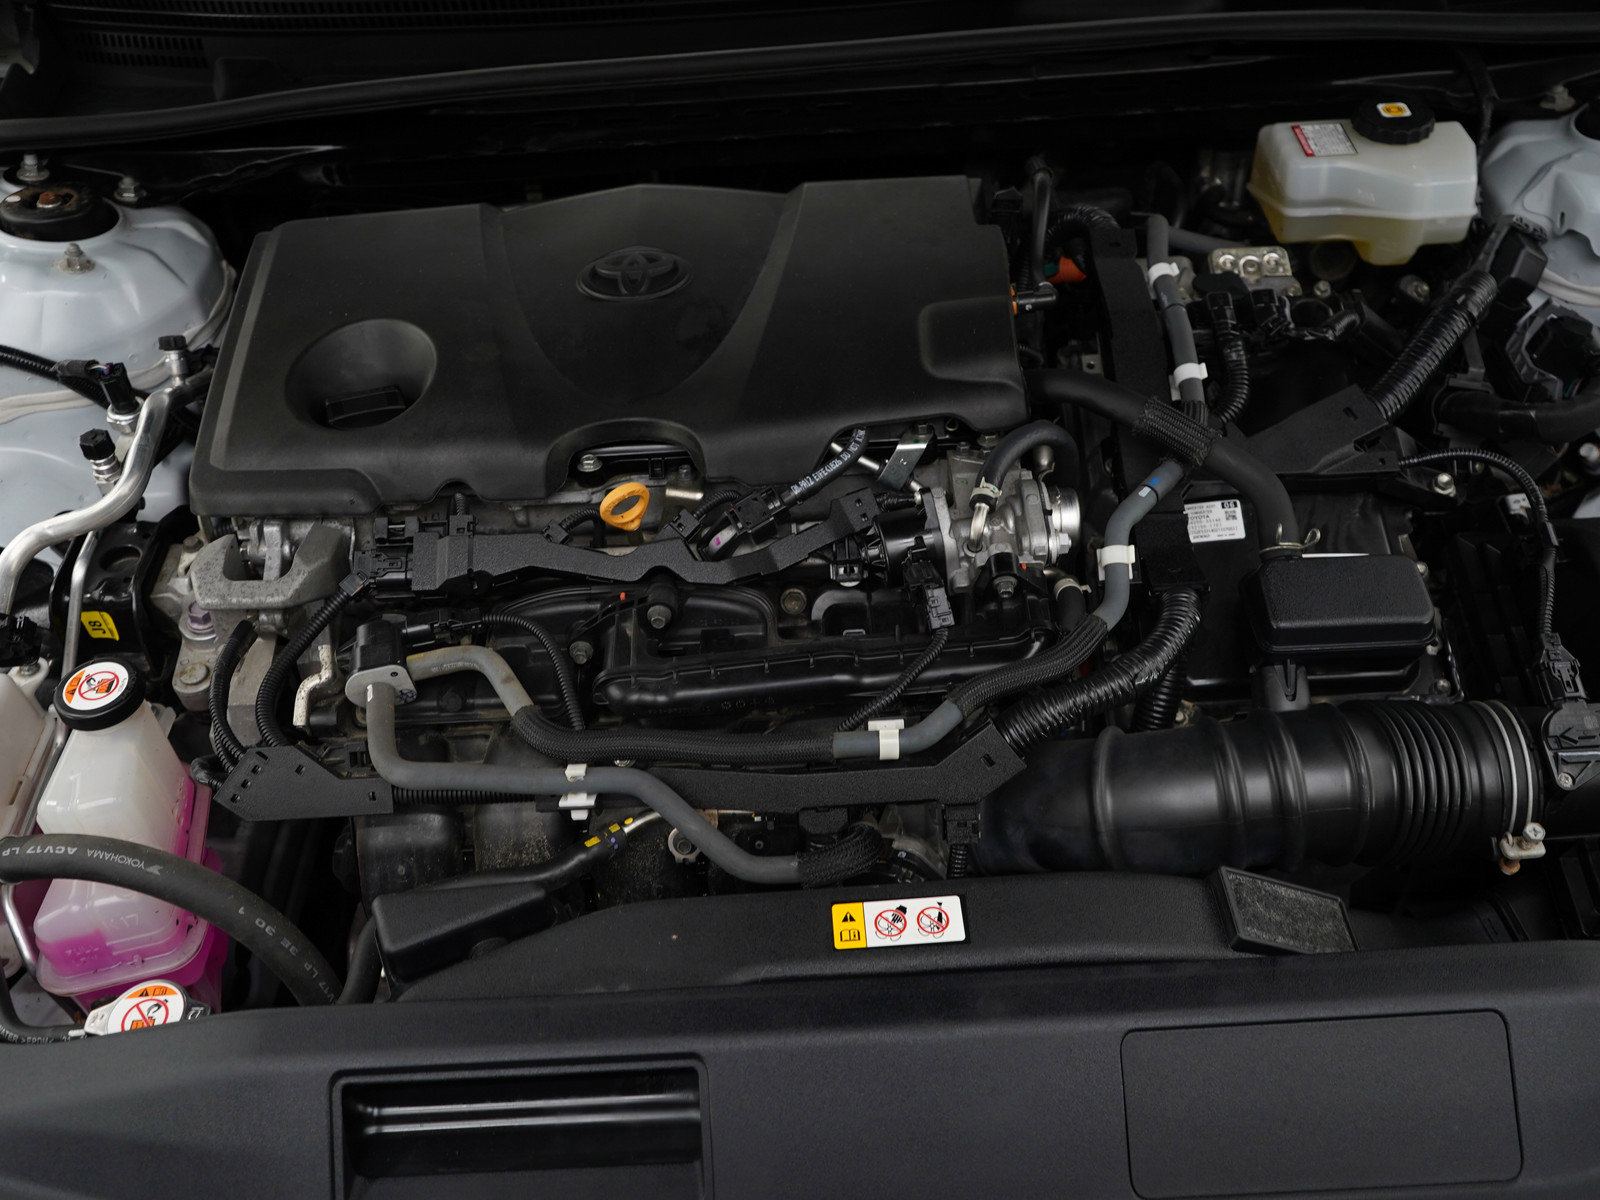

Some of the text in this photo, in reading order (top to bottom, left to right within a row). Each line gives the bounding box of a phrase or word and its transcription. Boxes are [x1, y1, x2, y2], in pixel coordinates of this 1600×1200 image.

[88, 620, 106, 634] J8
[2, 846, 145, 870] YOKOHAMA ACV17 LP
[304, 962, 318, 978] LP
[318, 981, 335, 1003] V17
